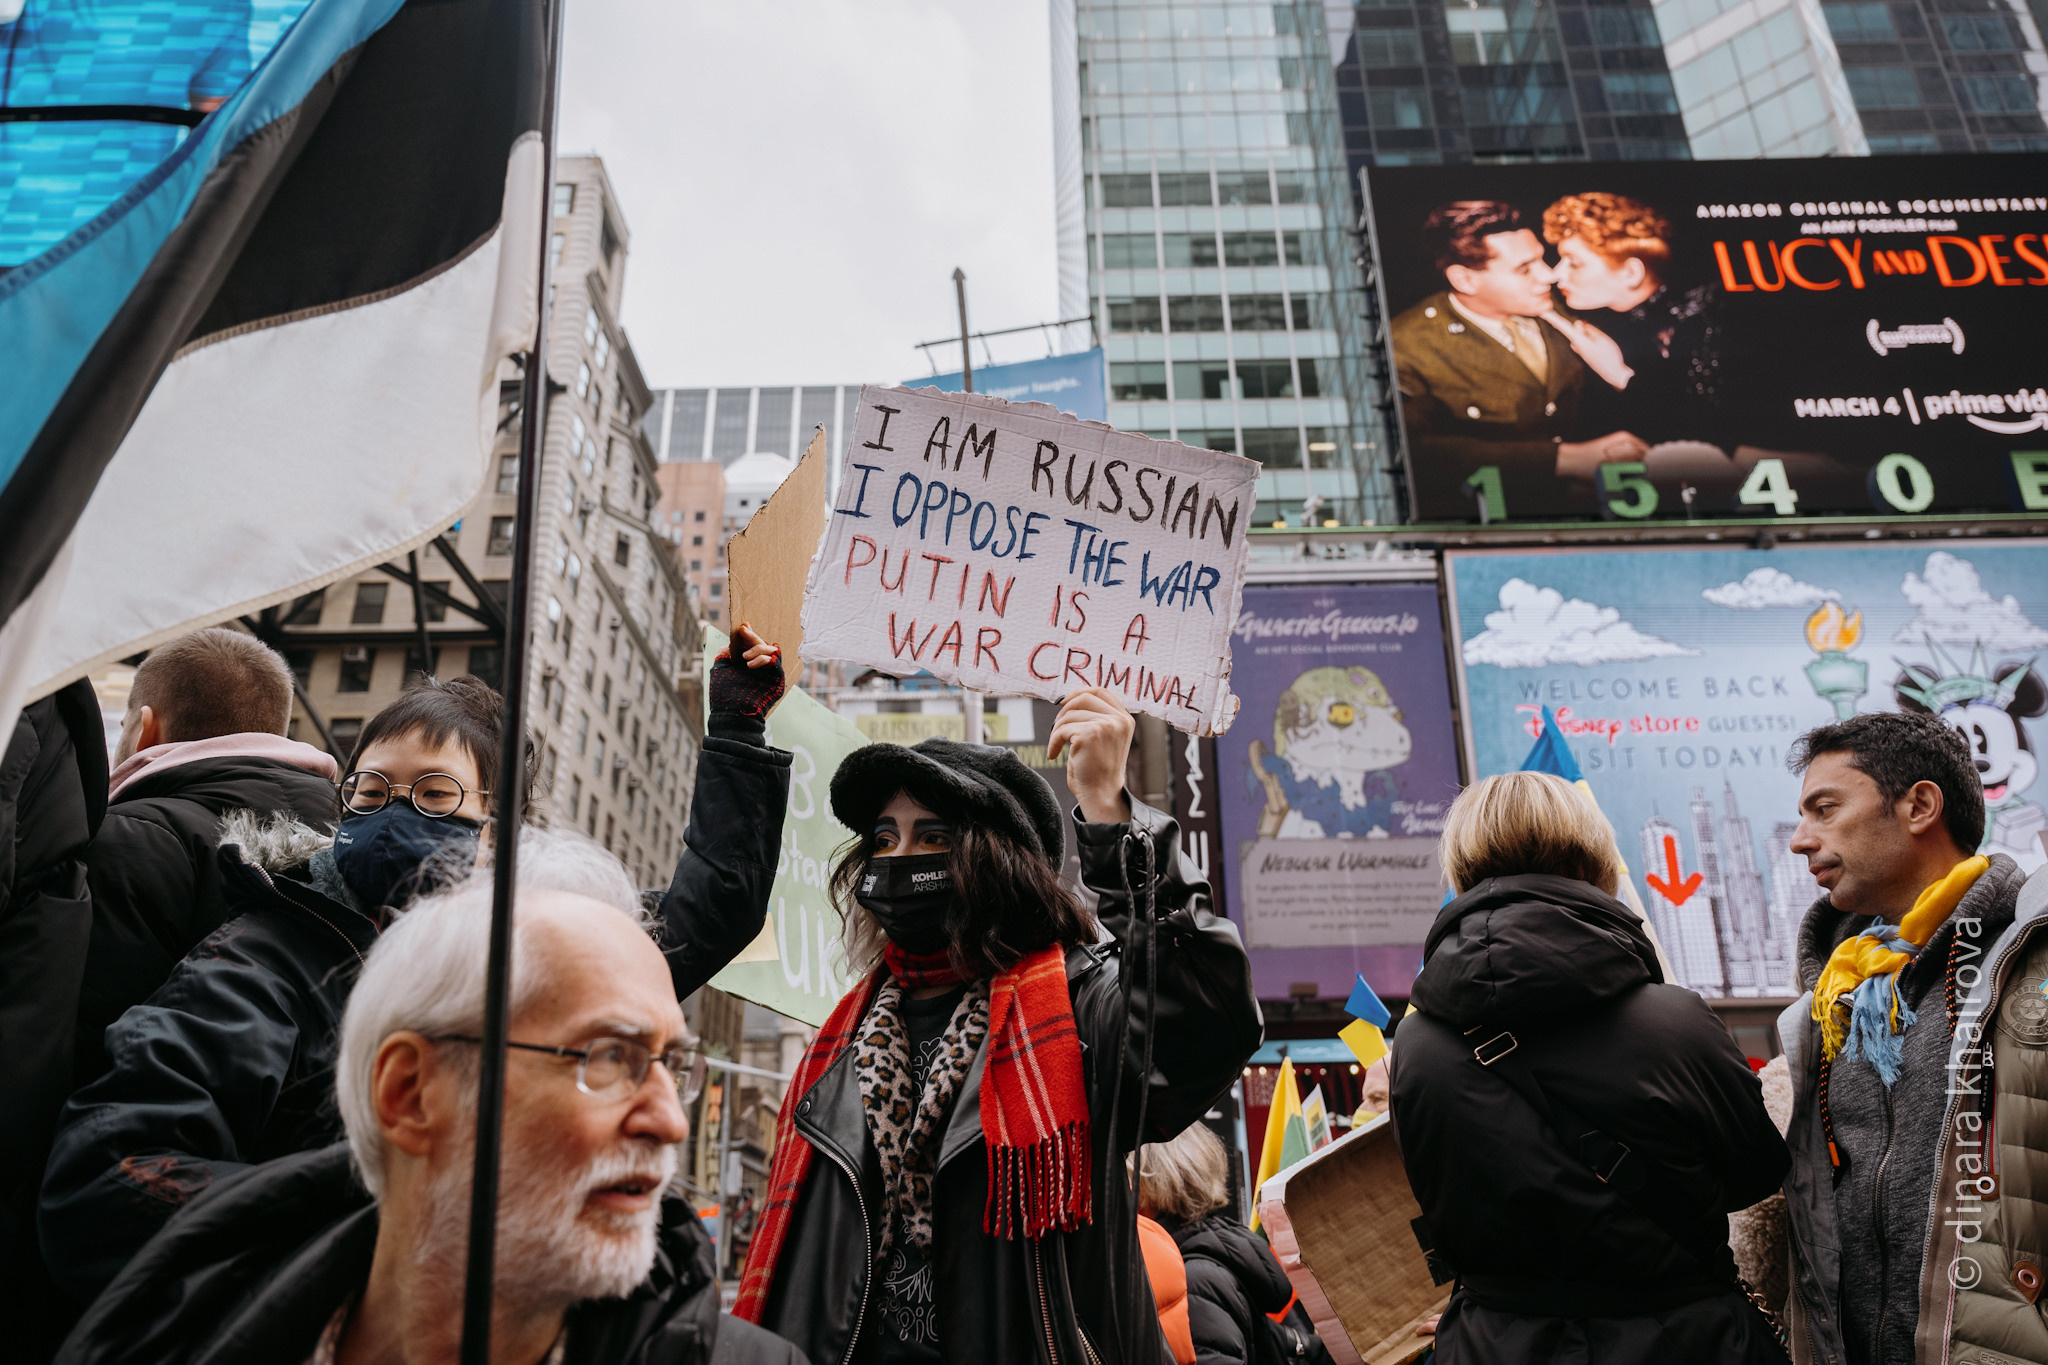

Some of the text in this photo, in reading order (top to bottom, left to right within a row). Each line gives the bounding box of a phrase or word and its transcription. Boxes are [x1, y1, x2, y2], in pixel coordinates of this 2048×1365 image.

[1696, 204, 1782, 218] AMAZON
[1789, 201, 1891, 216] ORIGINAL
[1713, 238, 1865, 292] LUCY
[1872, 249, 1927, 275] AND
[1794, 387, 2048, 420] MARCH 4 prime vid
[862, 404, 1239, 550] I AM RUSSIAN
[834, 463, 1222, 616] I OPPOSE THE WAR
[844, 534, 1152, 656] PUTIN IS A
[888, 610, 1204, 714] WAR CRIMINAL
[1518, 674, 1792, 702] WELCOME BACK
[1628, 712, 1701, 735] store
[1706, 713, 1798, 734] GUESTS!
[1655, 744, 1780, 770] TODAY!
